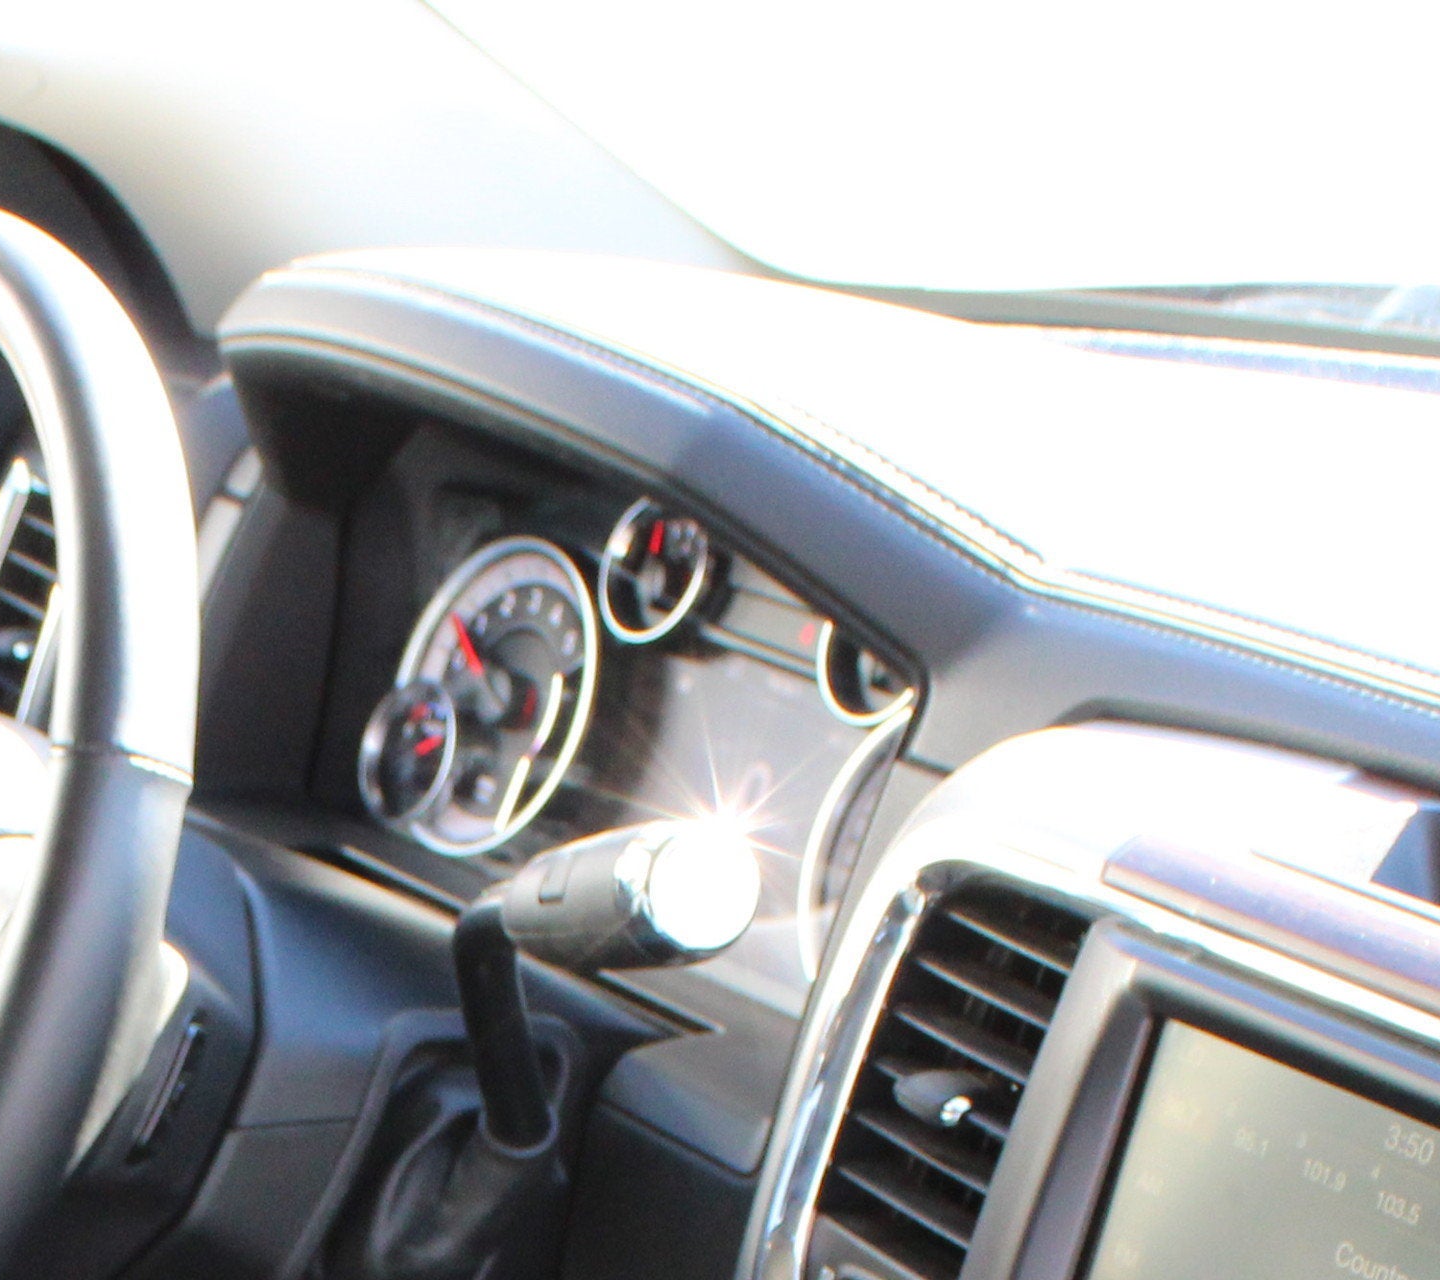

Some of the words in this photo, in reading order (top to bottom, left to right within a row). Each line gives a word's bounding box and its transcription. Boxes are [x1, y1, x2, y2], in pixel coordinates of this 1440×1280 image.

[499, 590, 517, 618] 2
[527, 587, 544, 615] 3
[548, 601, 565, 628] 4
[1384, 1122, 1436, 1166] 3:50
[1376, 1189, 1421, 1226] 103.5
